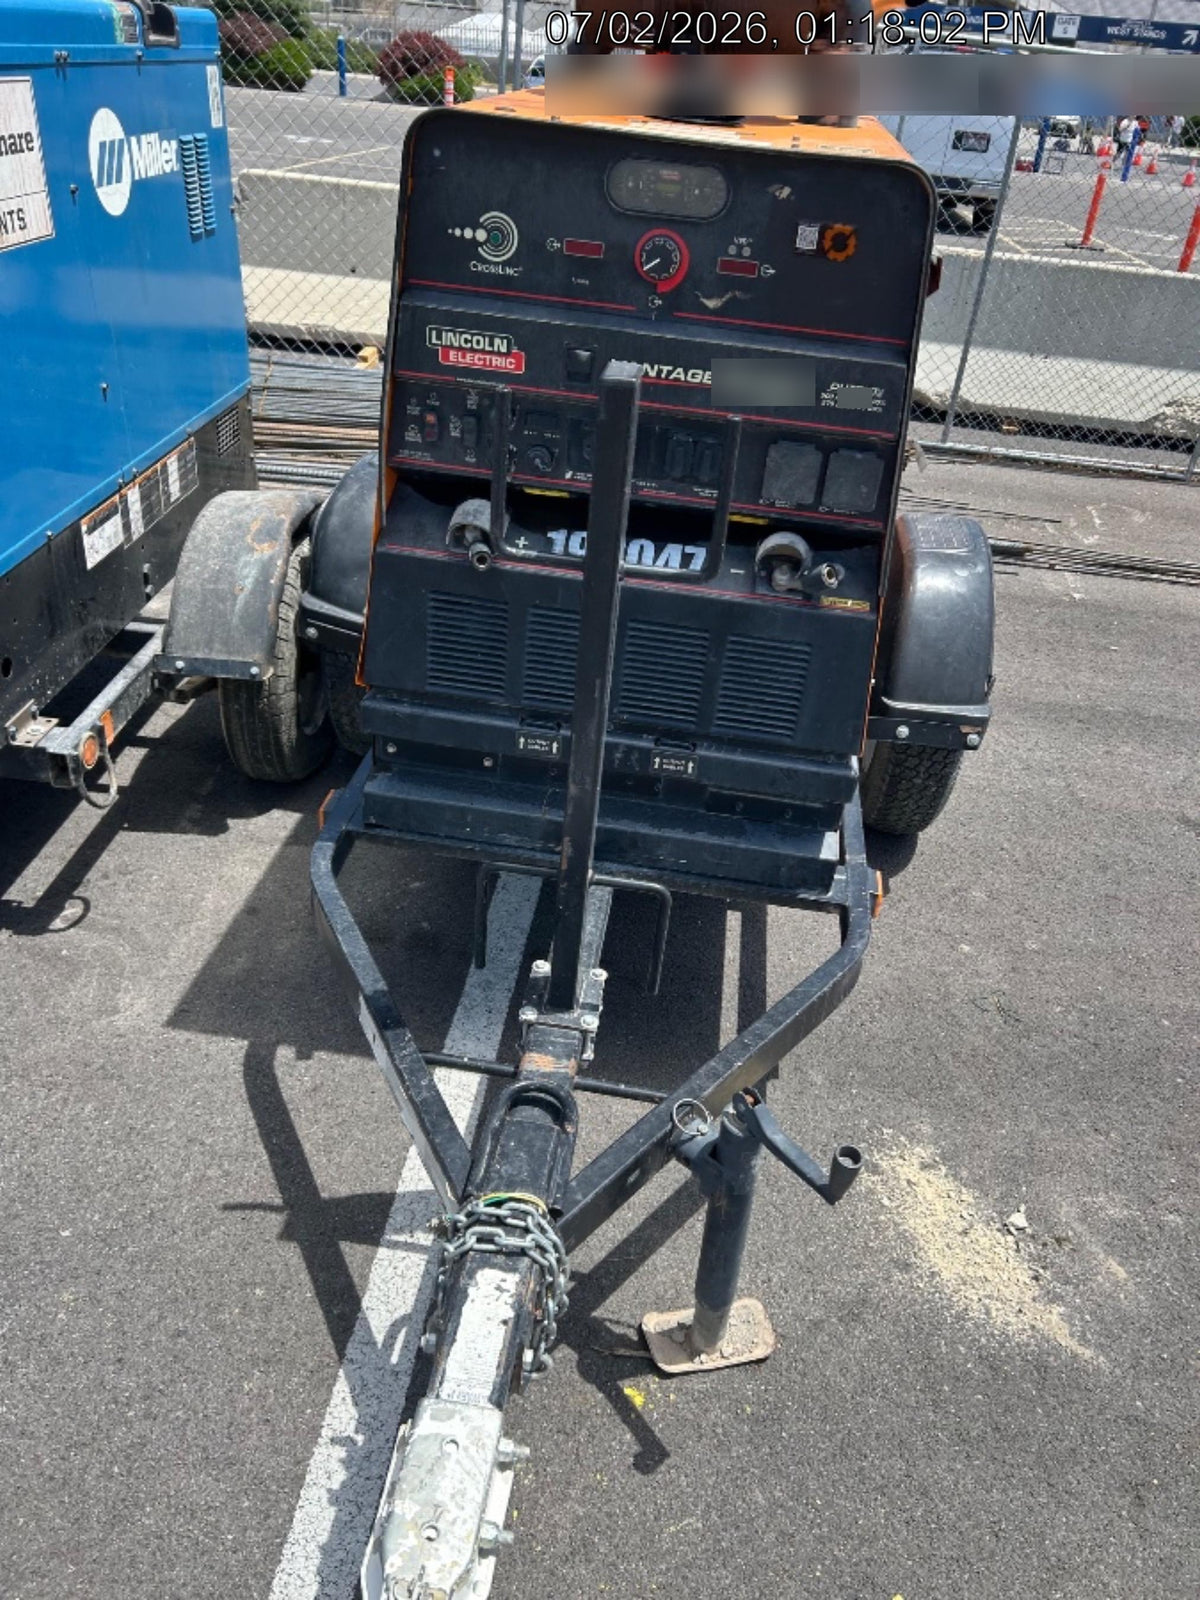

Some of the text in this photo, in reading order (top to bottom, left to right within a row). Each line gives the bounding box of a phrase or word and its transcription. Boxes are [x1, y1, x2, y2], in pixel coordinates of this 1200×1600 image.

[1106, 26, 1131, 37] WEST
[130, 132, 178, 180] Miller
[431, 329, 509, 354] LINCOLN
[449, 350, 517, 370] ELECTRIC
